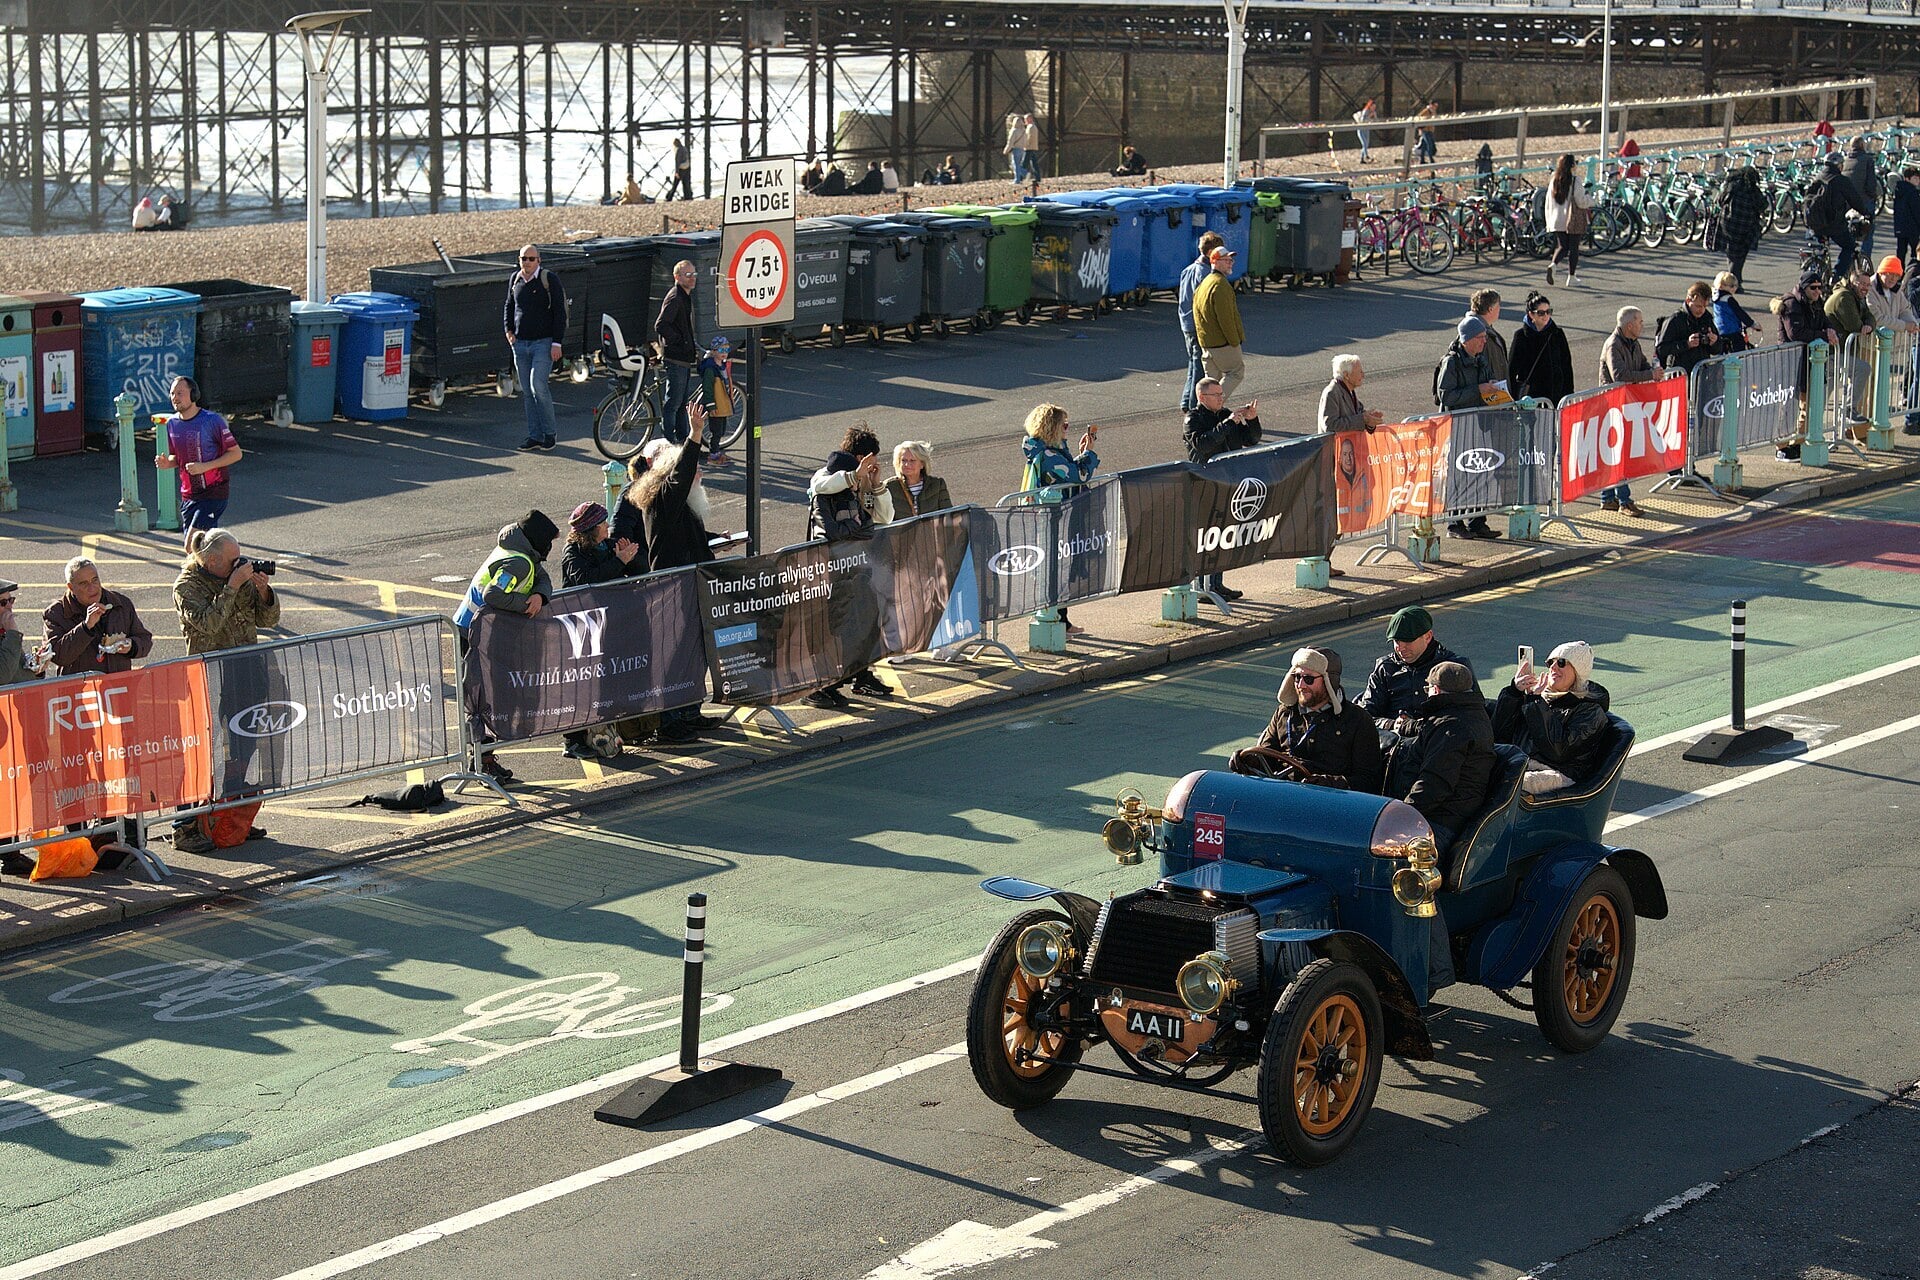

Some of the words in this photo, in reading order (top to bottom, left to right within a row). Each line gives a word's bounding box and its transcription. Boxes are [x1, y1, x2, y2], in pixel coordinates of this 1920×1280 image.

[740, 168, 784, 190] WEAK
[731, 192, 790, 214] BRIDGE
[809, 274, 837, 285] VEOLIA
[1749, 384, 1795, 409] Sotheby's
[1568, 396, 1682, 482] MOTUL
[1057, 529, 1112, 560] Sotheby's
[1197, 513, 1281, 553] LOCKTON
[707, 575, 756, 596] Thanks
[758, 572, 776, 588] for
[778, 564, 813, 586] rallying
[815, 562, 825, 576] to
[828, 551, 868, 574] support
[711, 604, 730, 618] our
[733, 590, 800, 614] automotive
[801, 580, 833, 601] family
[718, 627, 753, 643] ben.org.uk
[610, 654, 649, 675] YATES
[333, 681, 431, 719] Sotheby's
[7, 765, 23, 779] or
[27, 759, 58, 776] new,
[61, 747, 102, 768] we're
[107, 744, 142, 761] here
[145, 739, 159, 754] to
[163, 735, 179, 752] fix
[181, 733, 201, 753] you
[87, 782, 96, 797] TO
[1196, 827, 1223, 845] 245
[1130, 1012, 1162, 1036] AA
